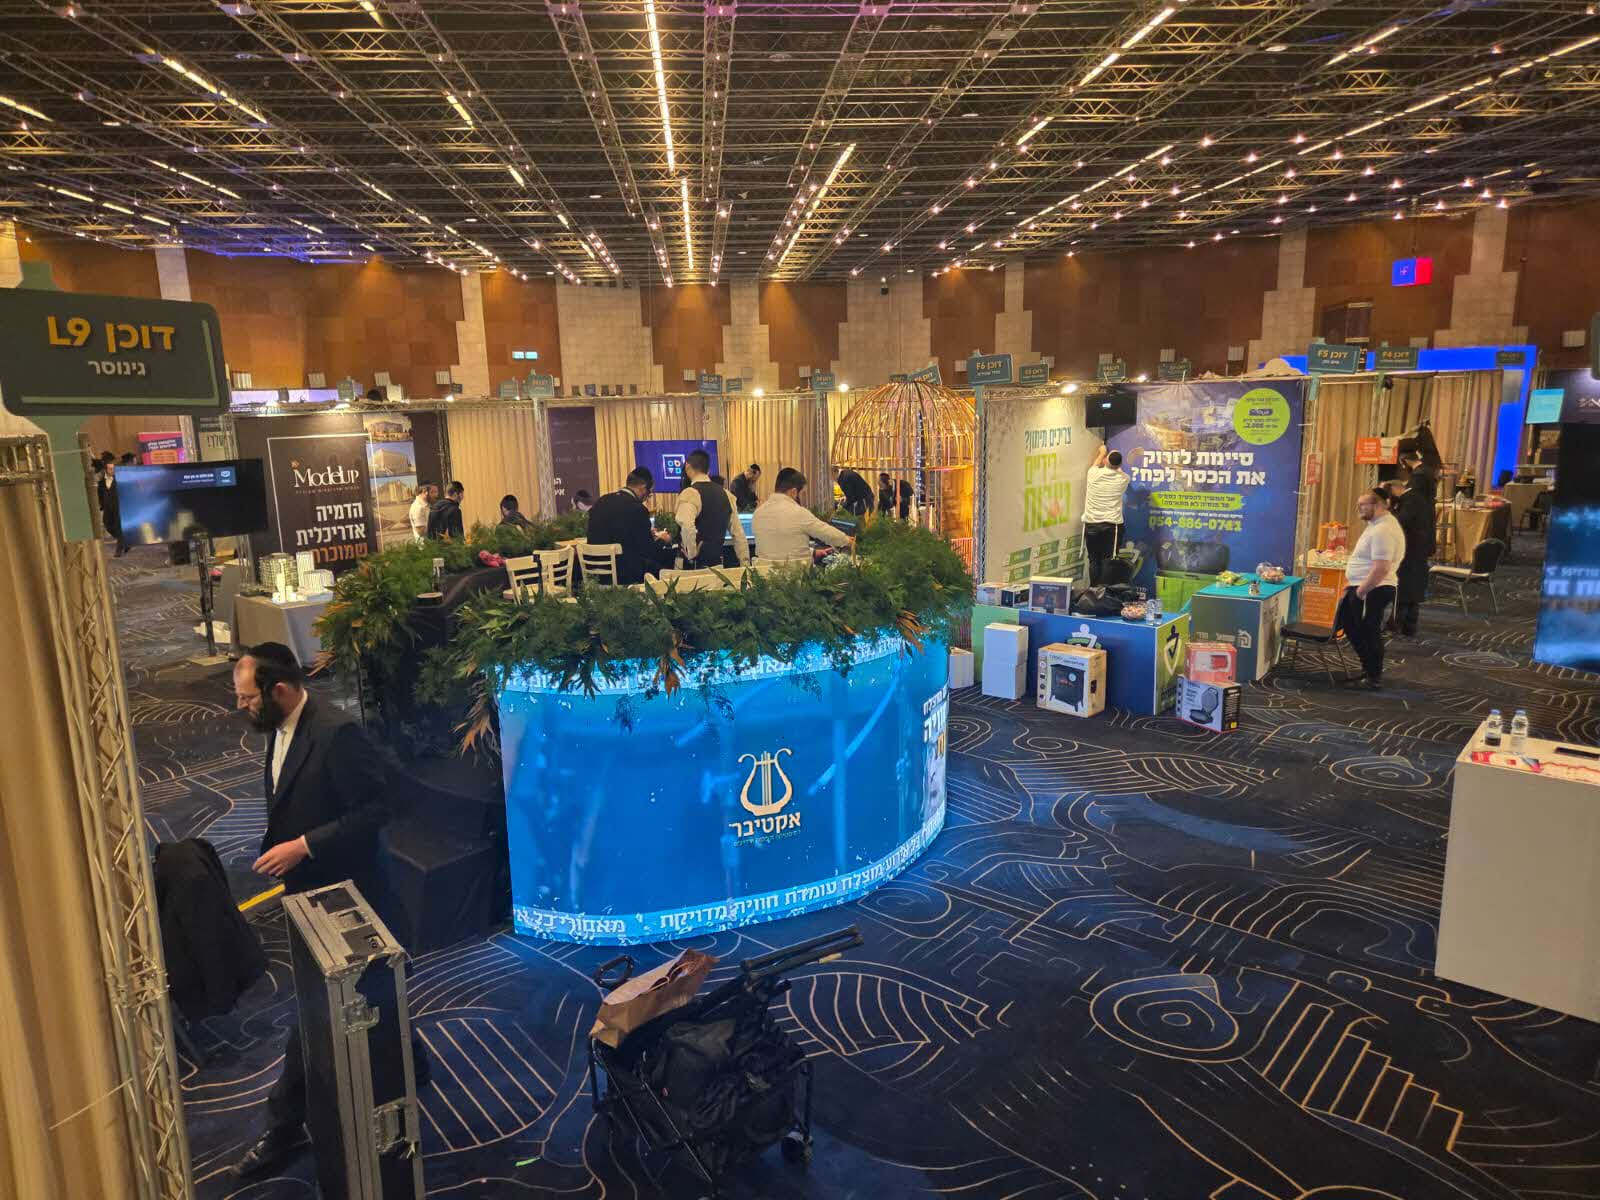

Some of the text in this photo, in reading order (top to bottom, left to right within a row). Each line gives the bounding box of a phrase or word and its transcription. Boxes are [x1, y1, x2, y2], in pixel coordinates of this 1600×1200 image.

[48, 316, 175, 353] דוכן L9
[88, 360, 146, 377] גינוסר
[1049, 427, 1072, 447] צריכים
[1143, 448, 1254, 468] סיימת לזרוק
[1131, 466, 1266, 488] את הכסף לפח?
[315, 501, 363, 522] הדמיה
[295, 523, 366, 546] אדריכלית
[728, 811, 801, 838] אקטיבר
[840, 863, 884, 893] מוצלח
[784, 879, 838, 906] עומדת
